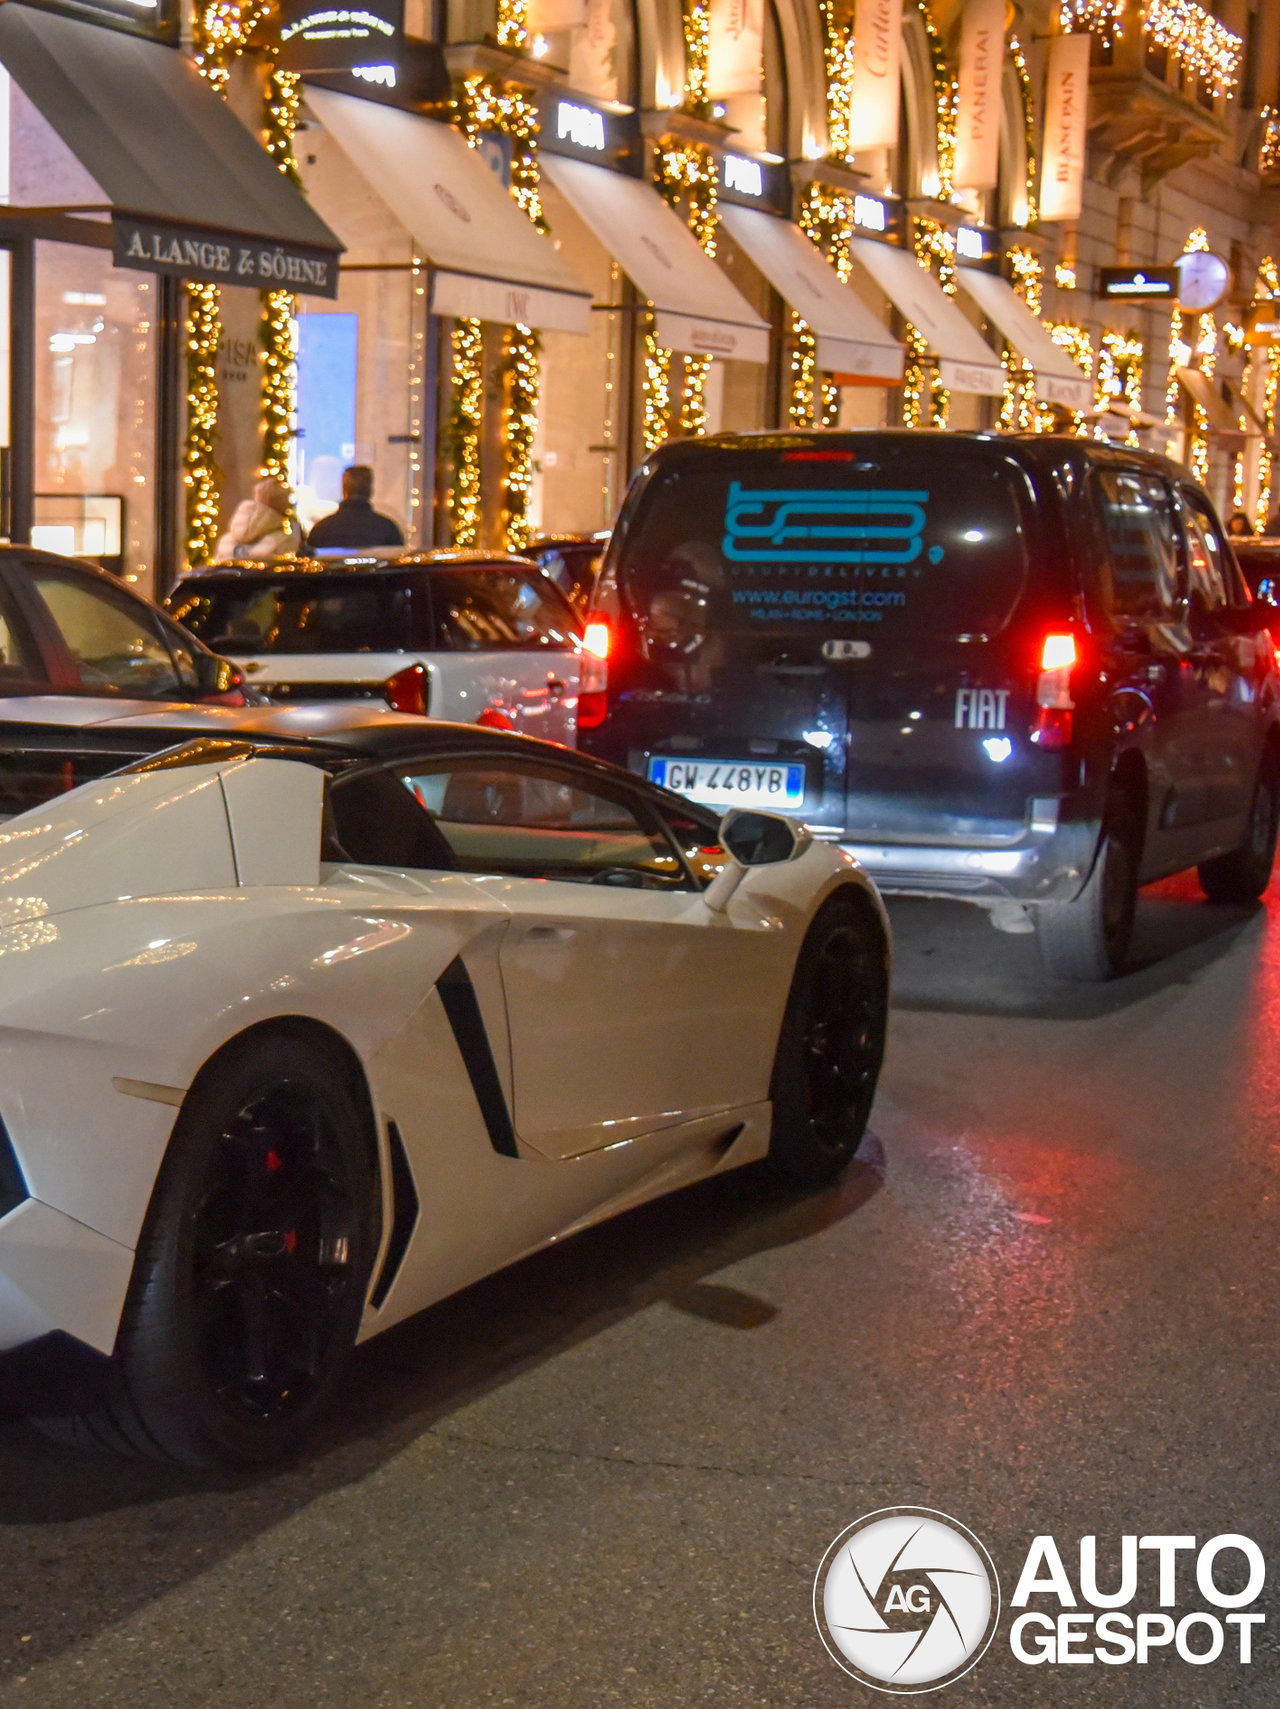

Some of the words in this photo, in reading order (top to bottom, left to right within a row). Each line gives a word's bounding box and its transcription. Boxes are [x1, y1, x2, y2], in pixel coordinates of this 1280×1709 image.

[864, 0, 890, 78] Cartie
[971, 29, 989, 140] PANERAI
[1057, 71, 1074, 182] BLANCPAIN
[153, 235, 230, 272] LANGE
[236, 249, 254, 275] &
[258, 247, 328, 286] SÖHNE
[955, 688, 1010, 729] FIAT
